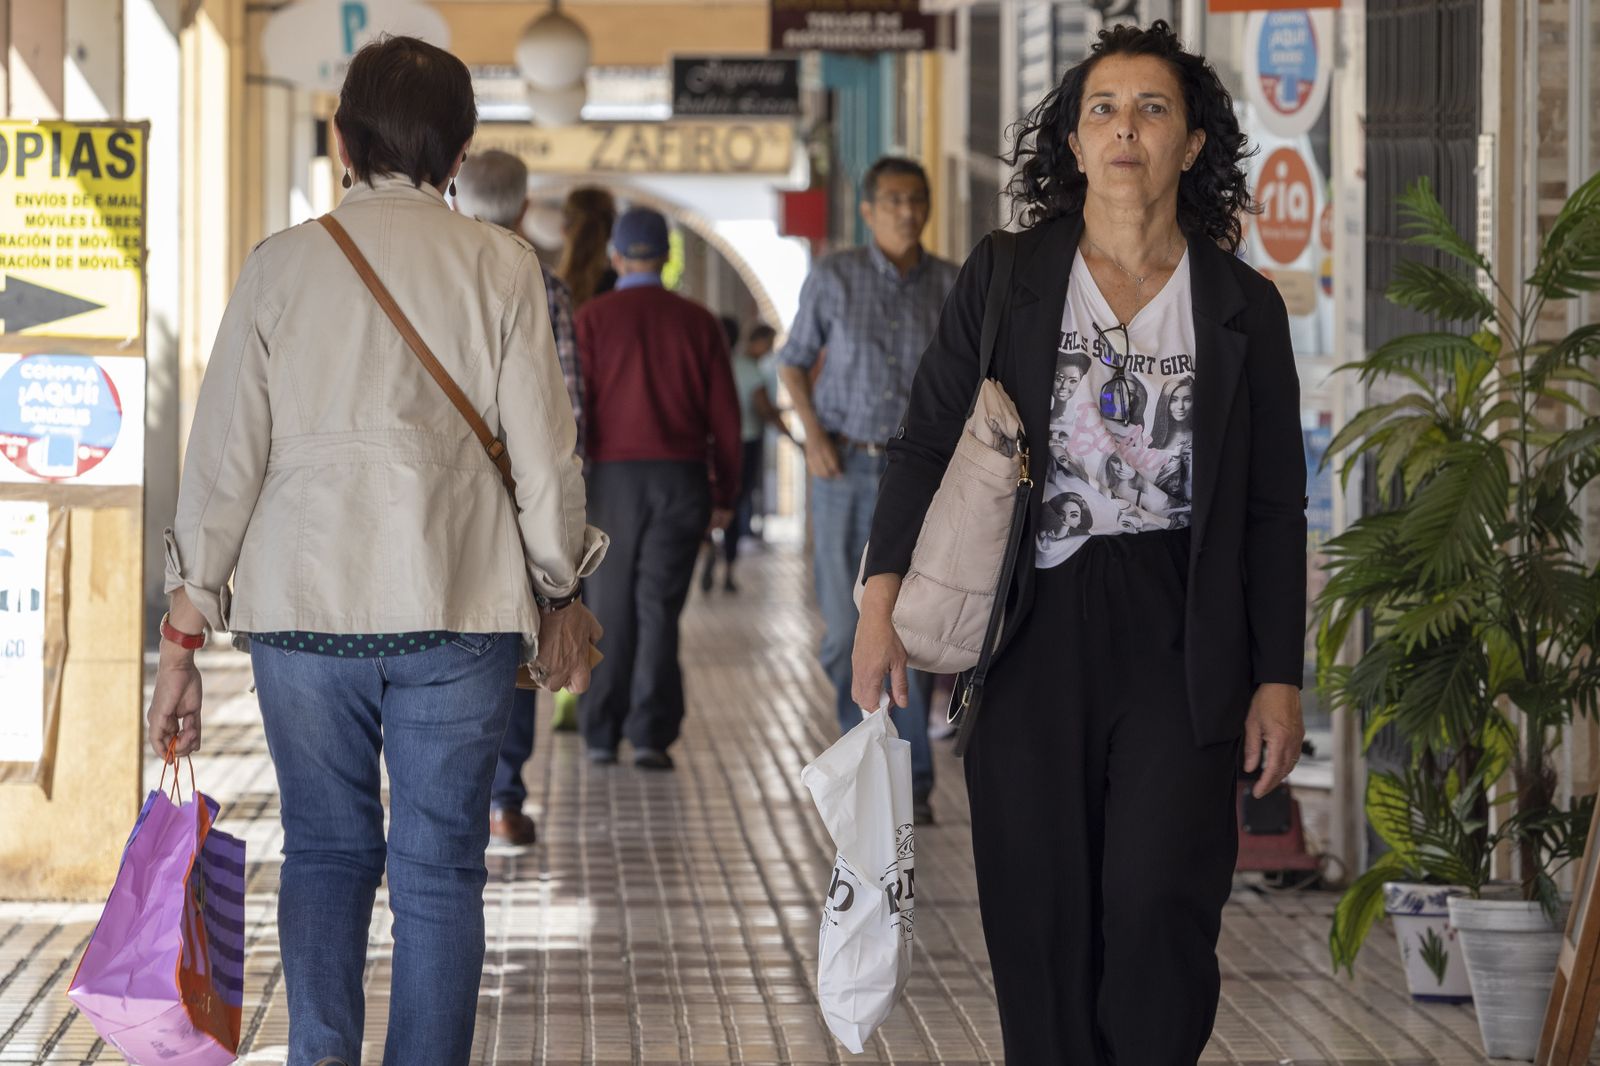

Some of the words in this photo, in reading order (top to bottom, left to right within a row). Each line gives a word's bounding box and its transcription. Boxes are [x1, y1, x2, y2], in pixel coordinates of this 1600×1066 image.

[15, 191, 67, 207] ENVÍOS
[72, 193, 90, 206] DE
[1261, 160, 1310, 223] ria
[25, 212, 87, 227] MÓVILES
[92, 215, 141, 228] LIBRES
[56, 236, 73, 248] DE
[80, 234, 141, 249] MÓVILES
[56, 256, 73, 268] DE
[79, 254, 141, 269] MÓVILES
[20, 363, 99, 383] COMPRA
